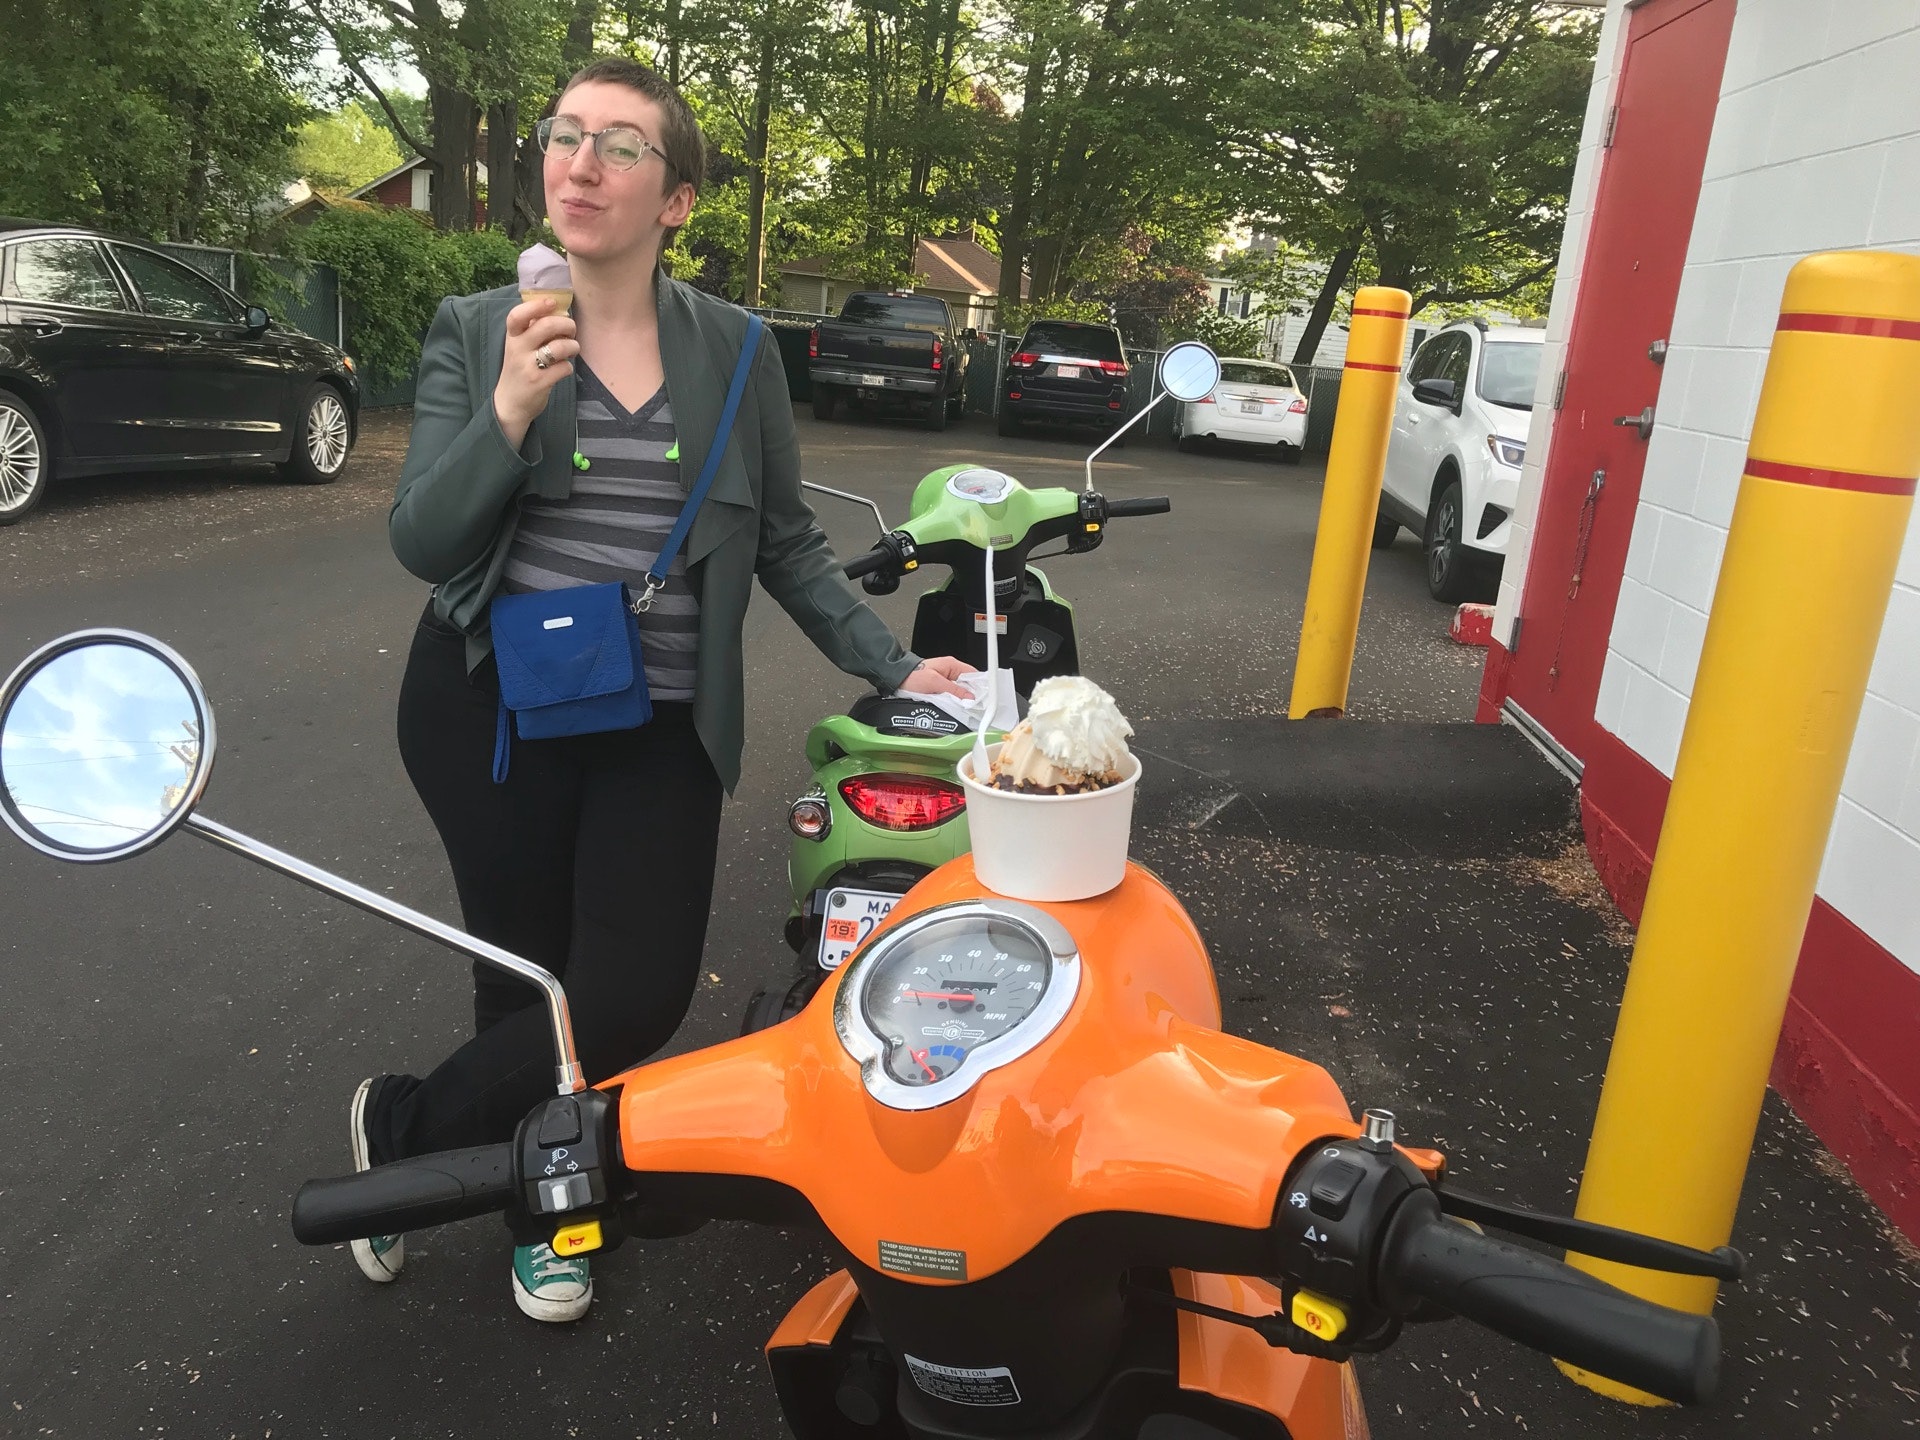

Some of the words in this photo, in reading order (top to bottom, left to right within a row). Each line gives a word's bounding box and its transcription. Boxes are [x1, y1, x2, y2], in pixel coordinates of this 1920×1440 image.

[910, 707, 940, 719] GENUINE
[867, 901, 892, 914] MA
[830, 924, 850, 936] 19
[967, 949, 982, 958] 40
[993, 952, 1009, 961] 50
[938, 954, 954, 963] 30
[912, 966, 928, 975] 20
[1016, 964, 1032, 972] 60
[897, 983, 910, 991] 10
[1027, 981, 1042, 990] 70
[892, 996, 901, 1004] 0
[983, 1012, 1007, 1021] MPH
[941, 1019, 969, 1029] GENUINE
[881, 1249, 898, 1257] CHANGE
[924, 1262, 939, 1270] EVERY
[923, 1363, 988, 1377] ATTENTION
